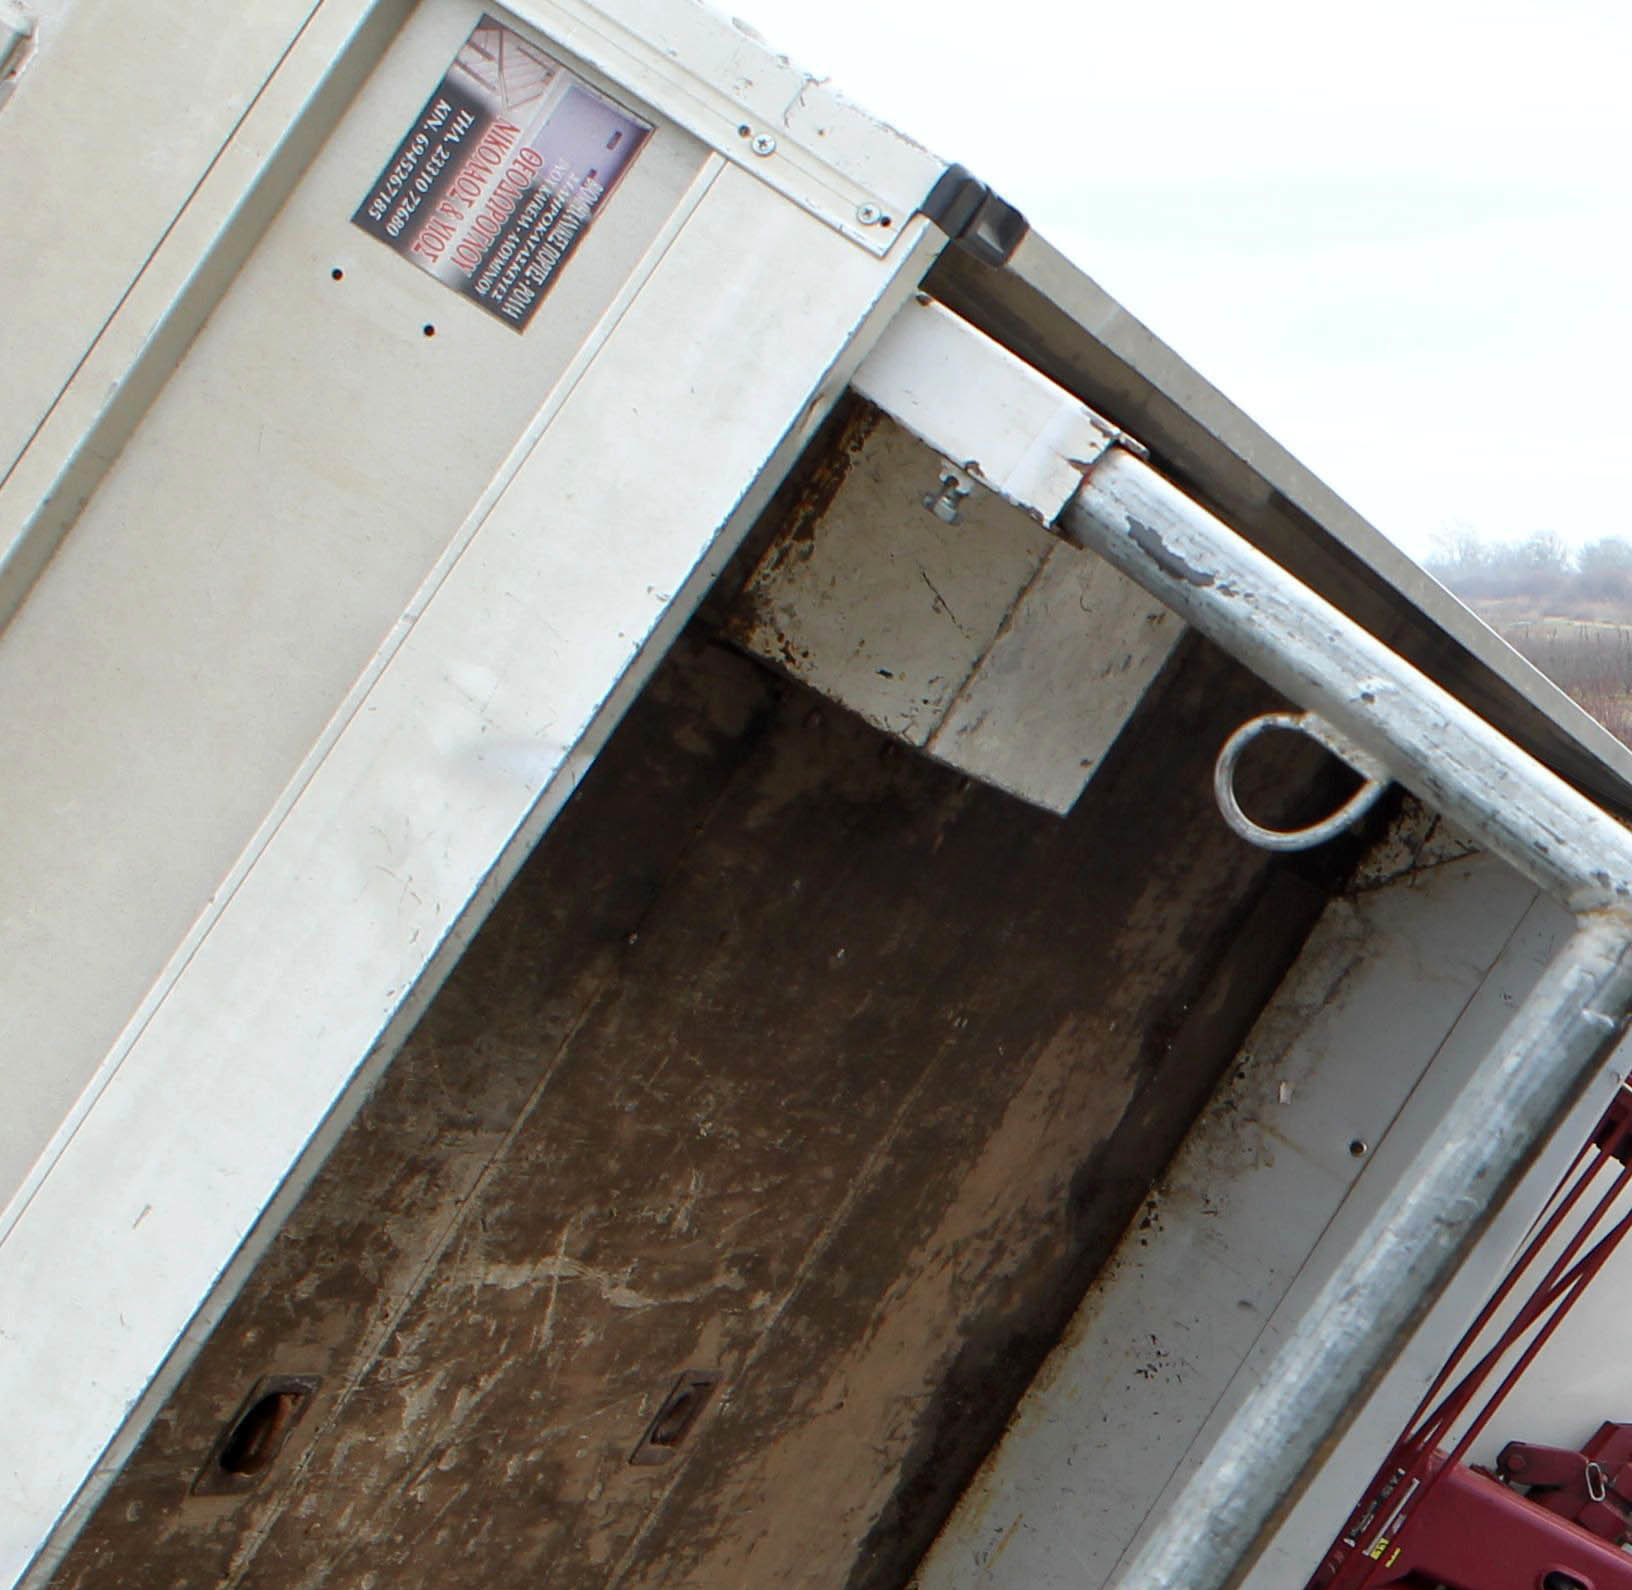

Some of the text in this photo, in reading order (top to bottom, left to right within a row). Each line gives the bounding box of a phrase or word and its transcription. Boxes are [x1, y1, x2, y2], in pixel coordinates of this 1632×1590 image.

[365, 131, 431, 221] 6945267185
[383, 188, 422, 238] 72680
[412, 114, 521, 264] ΝΙΚΟΛΑΟΣ & ΥΙΟΣ
[413, 144, 452, 192] 23310
[448, 143, 546, 277] ΘΕΟΔΩΡΟΓΛΟΥ
